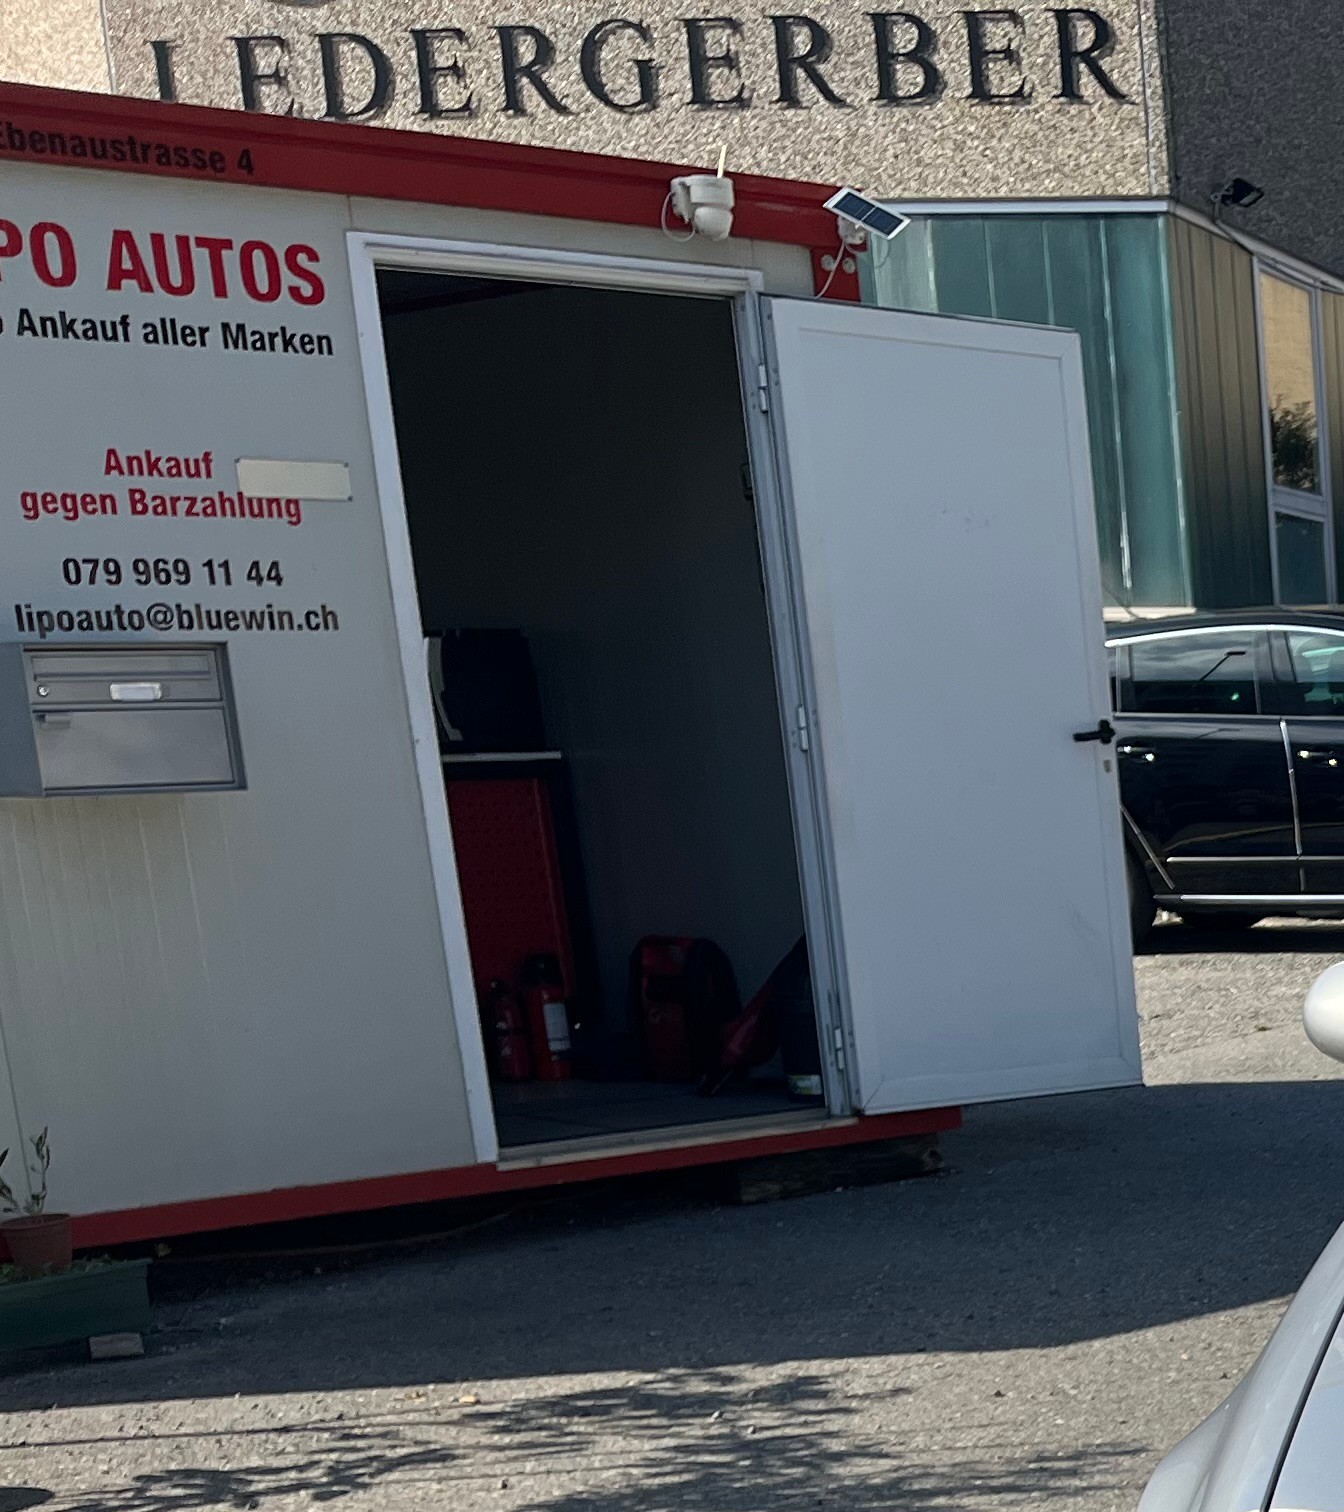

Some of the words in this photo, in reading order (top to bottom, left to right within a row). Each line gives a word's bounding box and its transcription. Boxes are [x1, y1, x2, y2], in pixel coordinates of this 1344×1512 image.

[236, 148, 255, 176] 4
[106, 229, 326, 306] AUTOS
[17, 308, 130, 343] Ankauf
[142, 316, 210, 348] aller
[220, 321, 334, 356] Marken
[103, 448, 214, 479] Ankauf
[19, 490, 118, 521] gegen
[127, 487, 302, 526] Barzahlung
[62, 557, 122, 586] 079
[132, 557, 191, 586] 969
[202, 558, 233, 586] 11
[246, 560, 283, 586] 44
[14, 602, 340, 639] lipoauto@bluewin.ch
